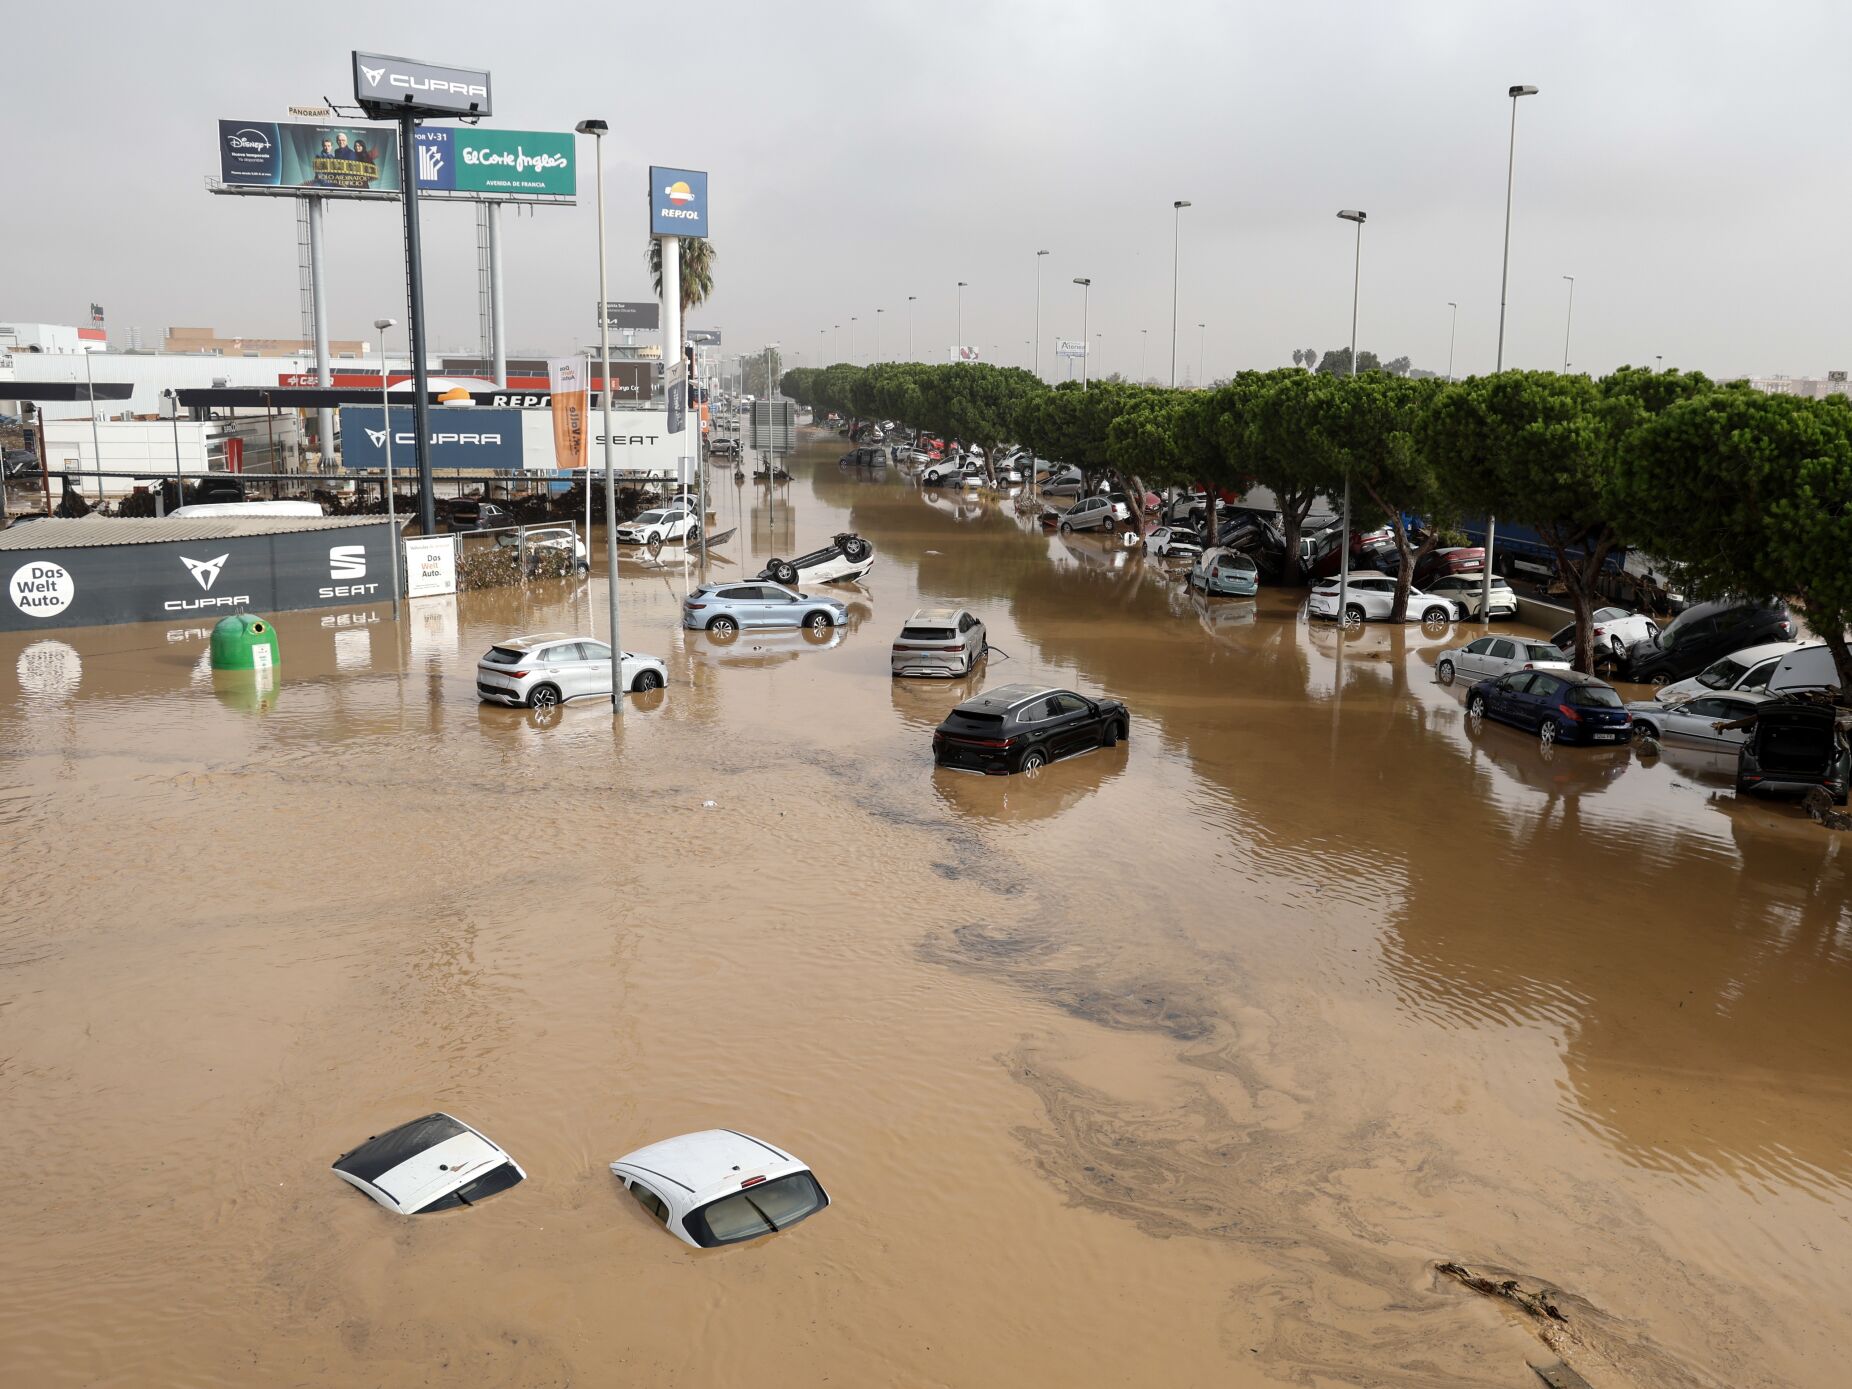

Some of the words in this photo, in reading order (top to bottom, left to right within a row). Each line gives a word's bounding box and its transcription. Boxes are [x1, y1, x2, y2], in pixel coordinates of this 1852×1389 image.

[389, 74, 488, 98] CUPRA
[288, 107, 331, 116] PANORAMIX
[427, 132, 447, 141] V-31
[462, 147, 479, 165] El
[479, 148, 515, 165] Corte
[515, 146, 568, 172] Inglés
[661, 208, 699, 220] REPSOL
[395, 433, 502, 445] CPRA
[595, 435, 659, 445] SEAT
[427, 554, 441, 562] Das
[420, 562, 439, 570] Welt
[31, 567, 64, 579] Das
[17, 580, 58, 594] Welt
[319, 583, 379, 598] SEAT
[19, 595, 65, 608] Auto.
[164, 595, 250, 611] CUPRA
